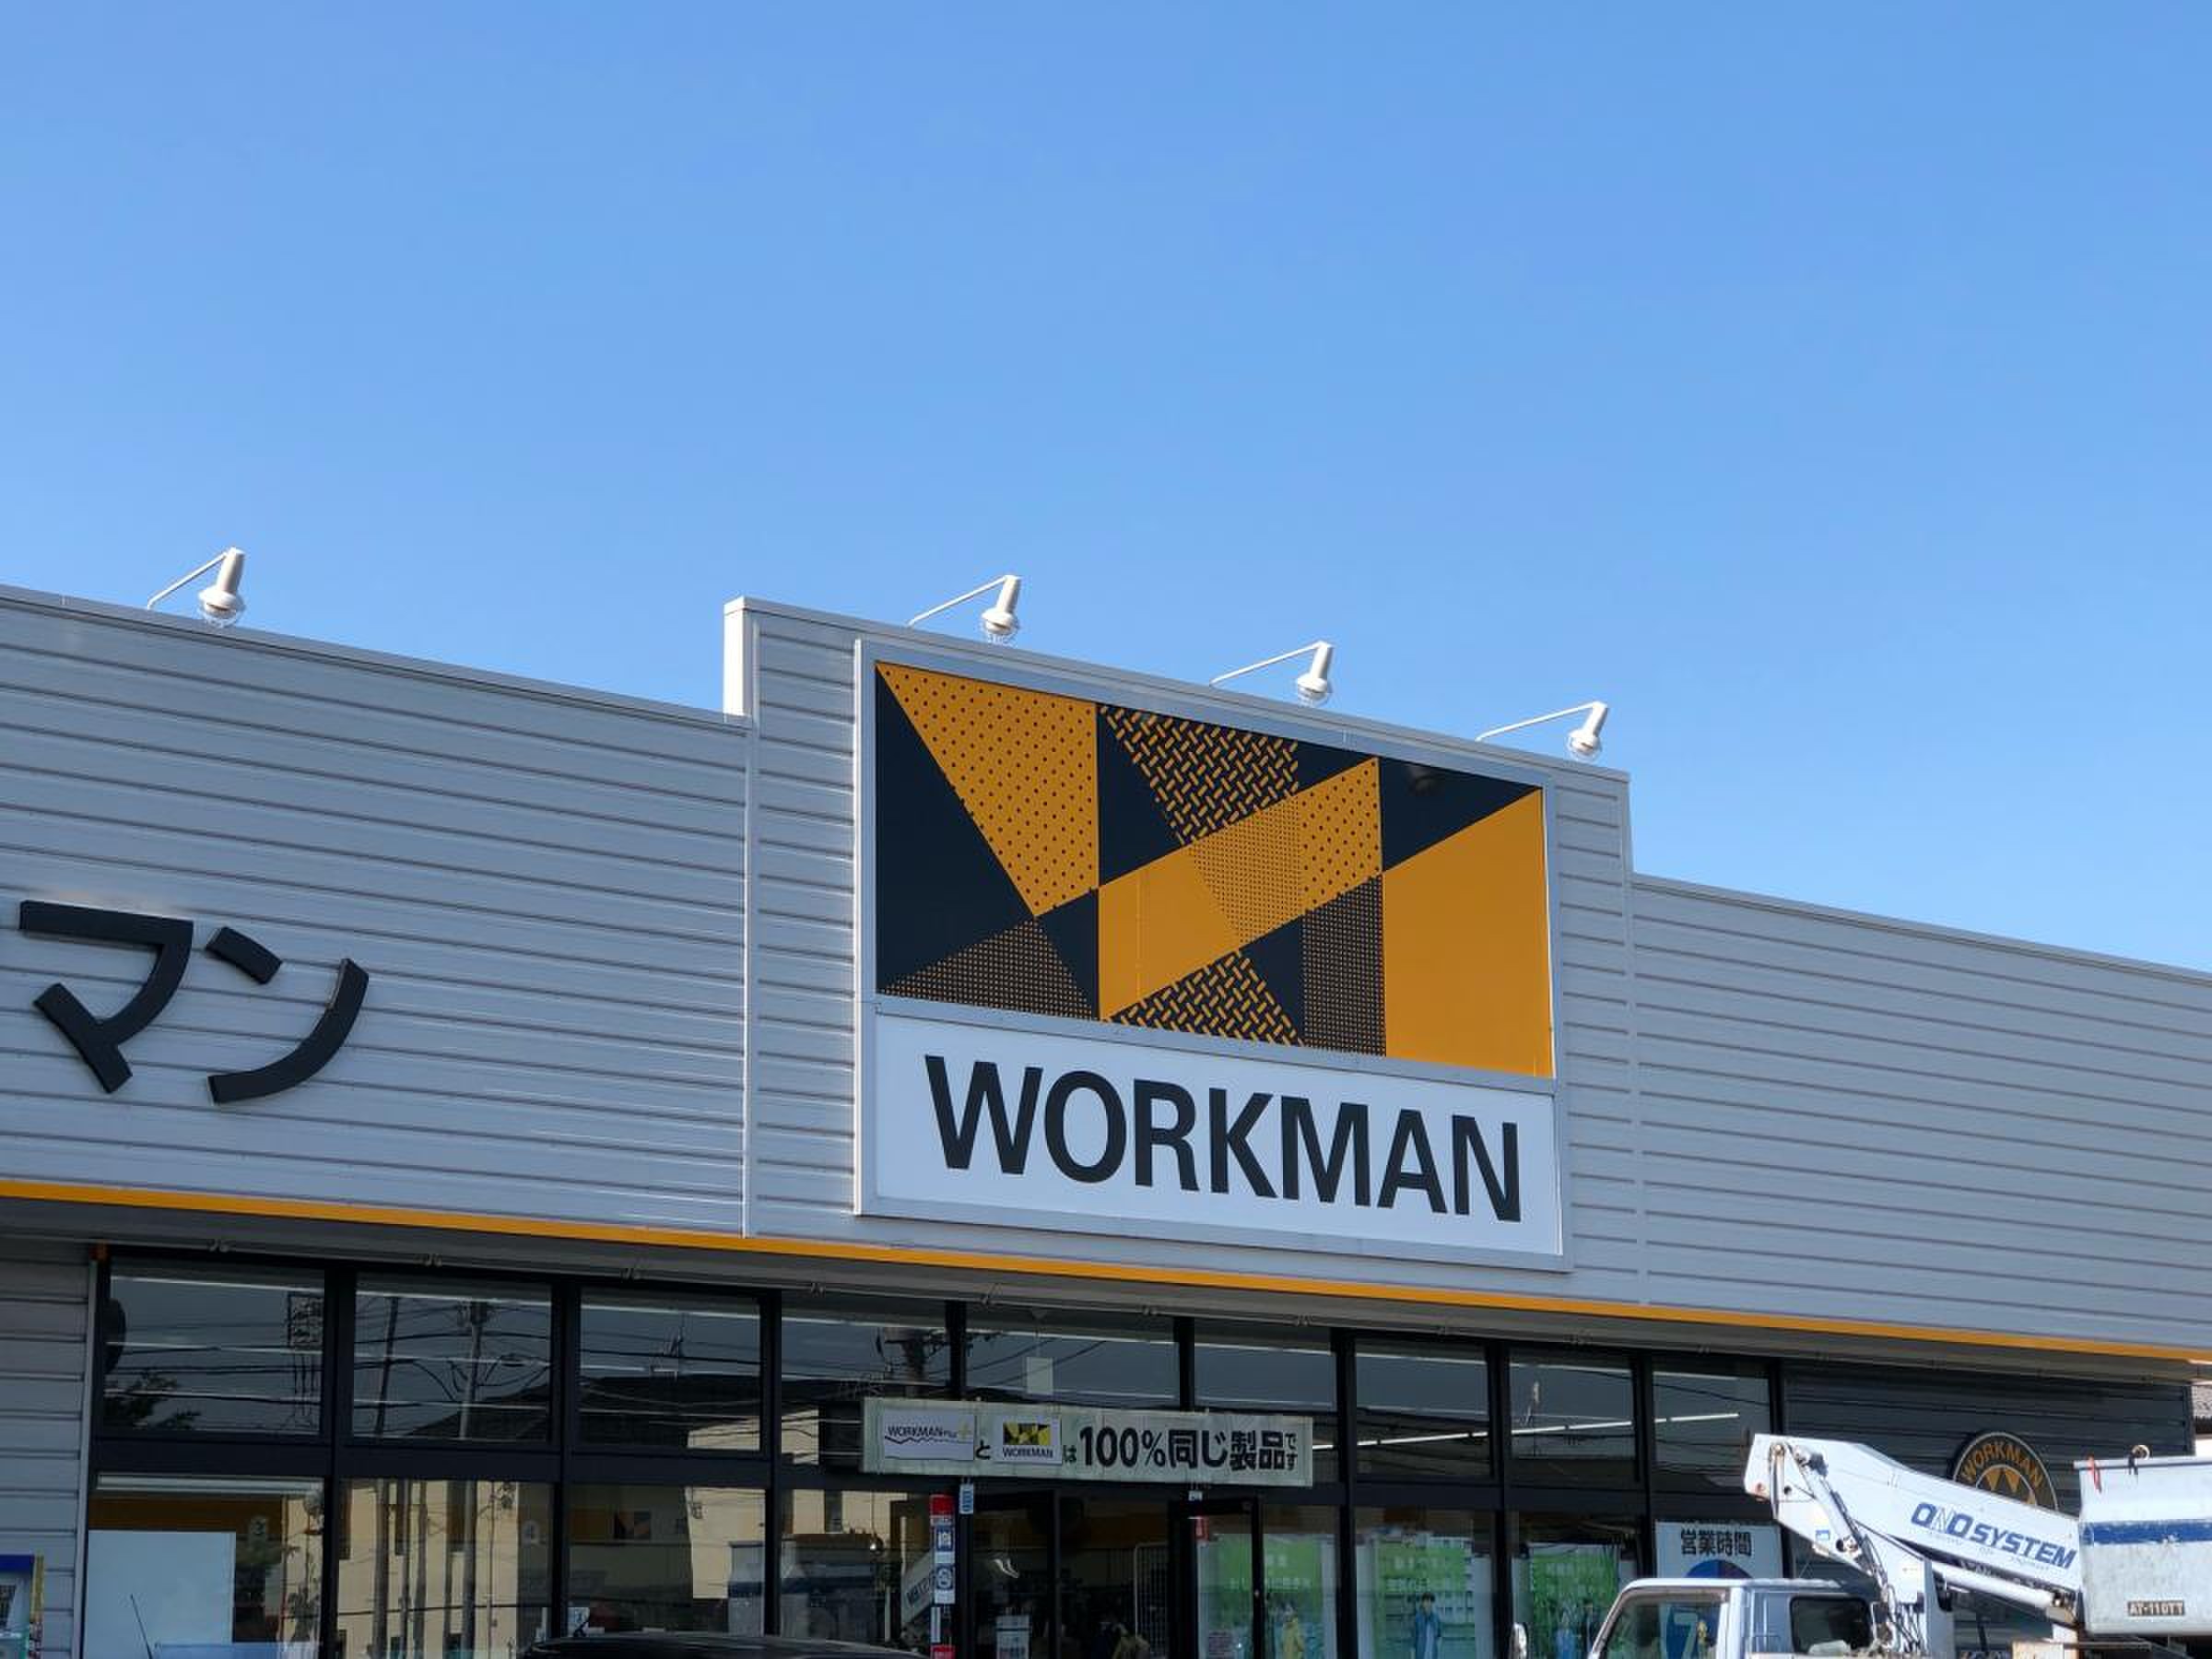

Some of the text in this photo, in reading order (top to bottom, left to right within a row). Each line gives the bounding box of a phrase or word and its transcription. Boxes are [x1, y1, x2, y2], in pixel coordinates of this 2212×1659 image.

[19, 900, 369, 1104] マン
[924, 1053, 1522, 1223] WORKMAN
[888, 1426, 943, 1438] WORKMAN
[975, 1440, 991, 1460] と
[1002, 1446, 1053, 1459] WORKMAN
[1680, 1529, 1752, 1557] 営業時間
[1969, 1523, 2078, 1570] SYSTEM
